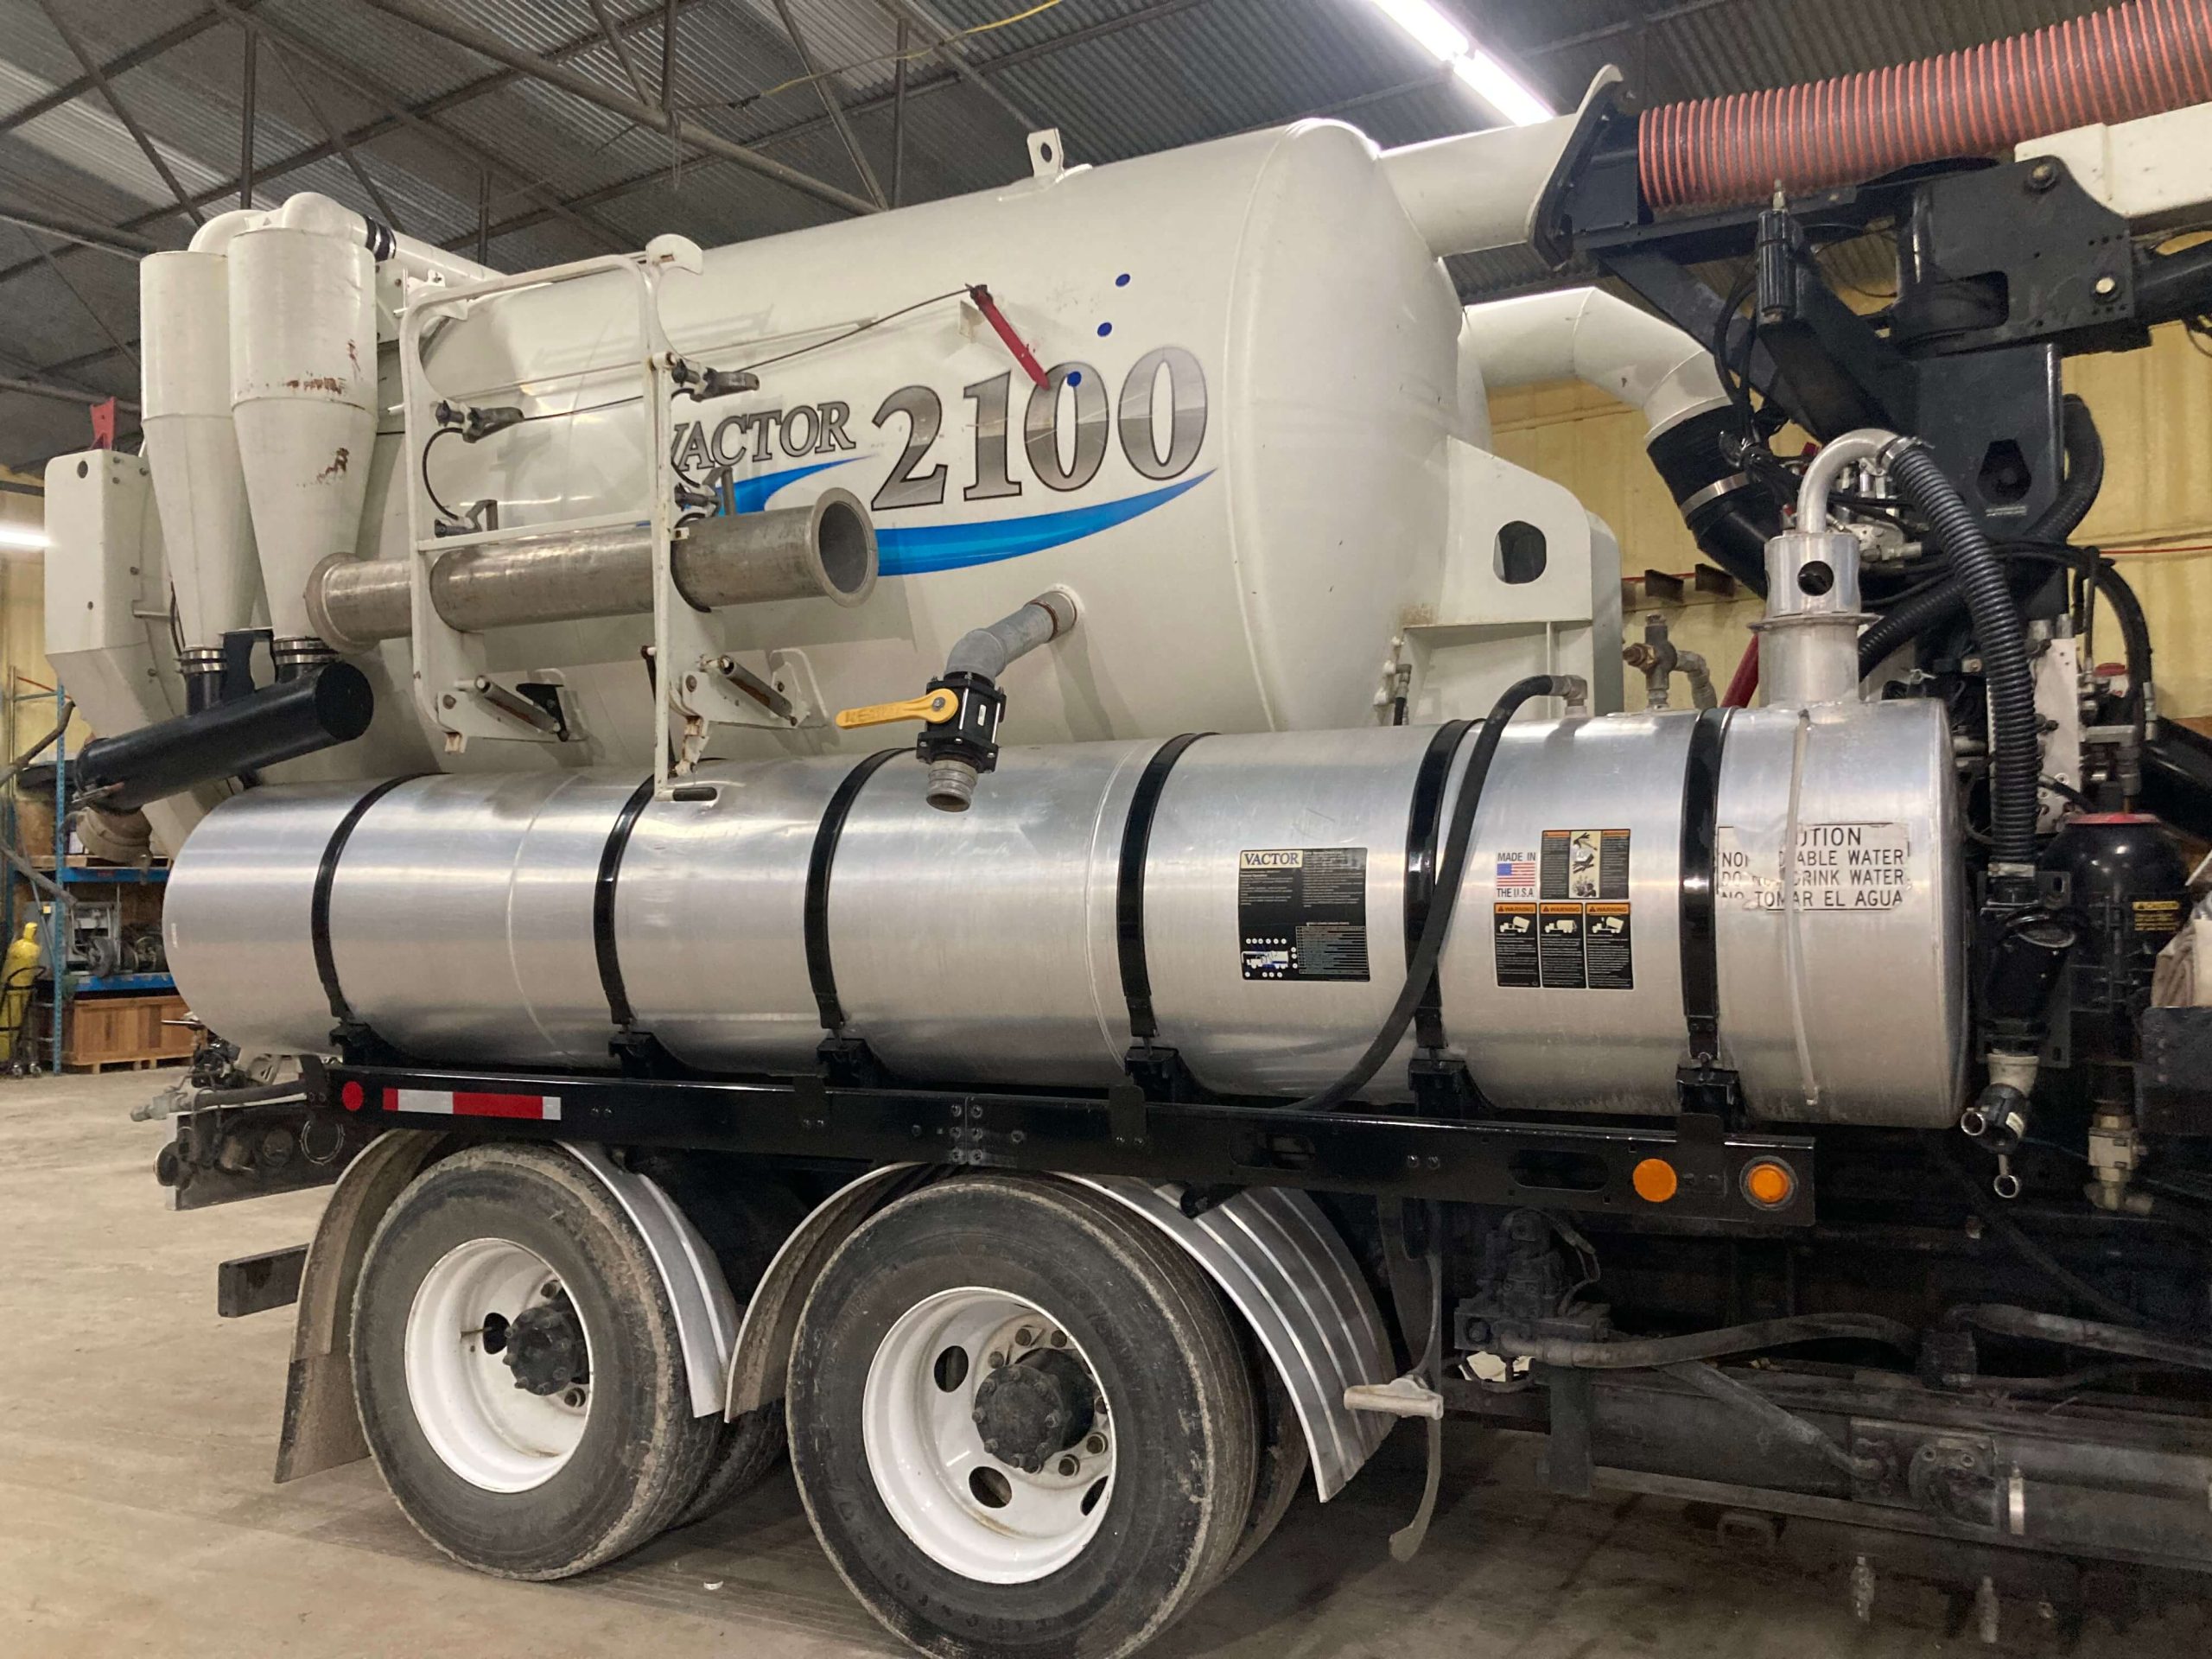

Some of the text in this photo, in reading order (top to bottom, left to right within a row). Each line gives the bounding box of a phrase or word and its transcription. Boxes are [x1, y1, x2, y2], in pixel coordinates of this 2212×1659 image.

[871, 346, 1209, 512] 2100
[1244, 852, 1300, 866] VACTOR
[1497, 852, 1536, 862] MADE IN
[1848, 849, 1904, 866] WATER
[1849, 868, 1904, 886] WATER
[1497, 887, 1513, 898] THE
[1824, 890, 1846, 906] EL
[1854, 889, 1904, 906] AGUA
